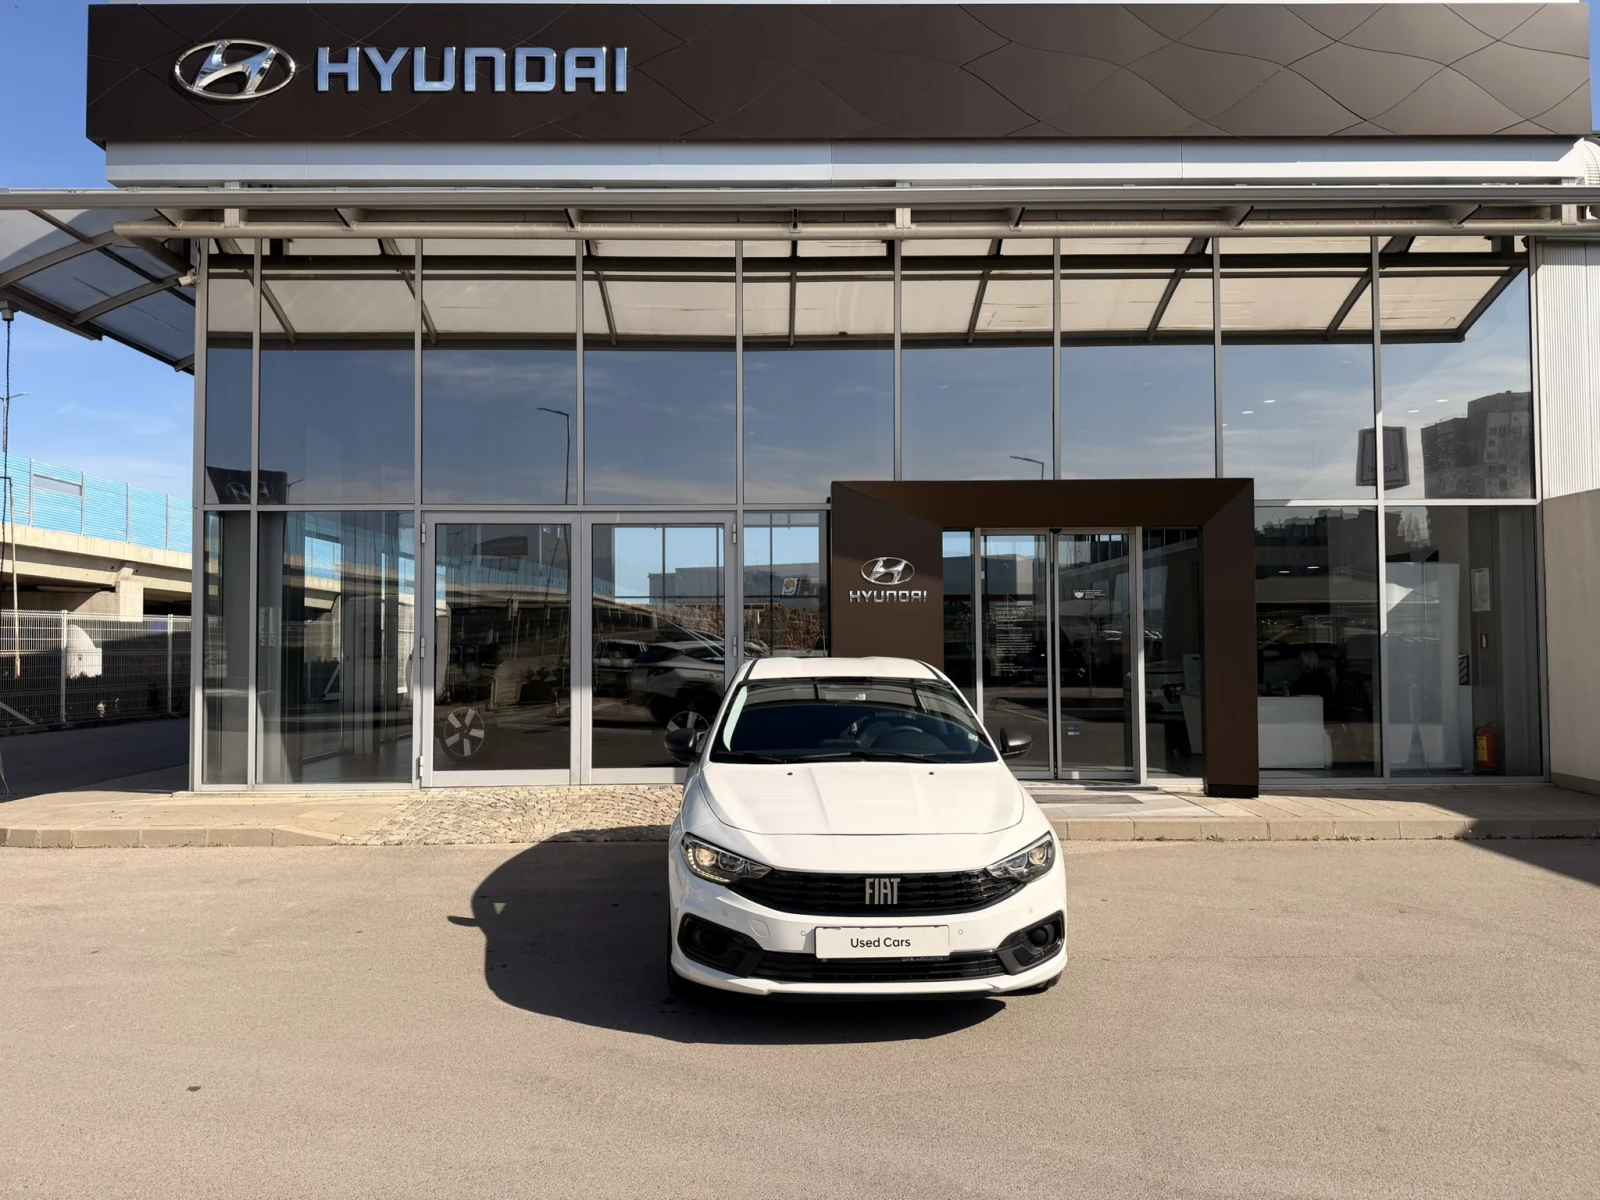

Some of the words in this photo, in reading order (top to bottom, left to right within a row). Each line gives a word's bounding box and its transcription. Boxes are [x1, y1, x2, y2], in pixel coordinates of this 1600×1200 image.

[317, 46, 628, 93] HYUNDAI
[849, 590, 927, 603] HYUNDAI
[865, 877, 901, 905] FIAT
[850, 937, 881, 948] Used
[883, 937, 911, 948] Cars
